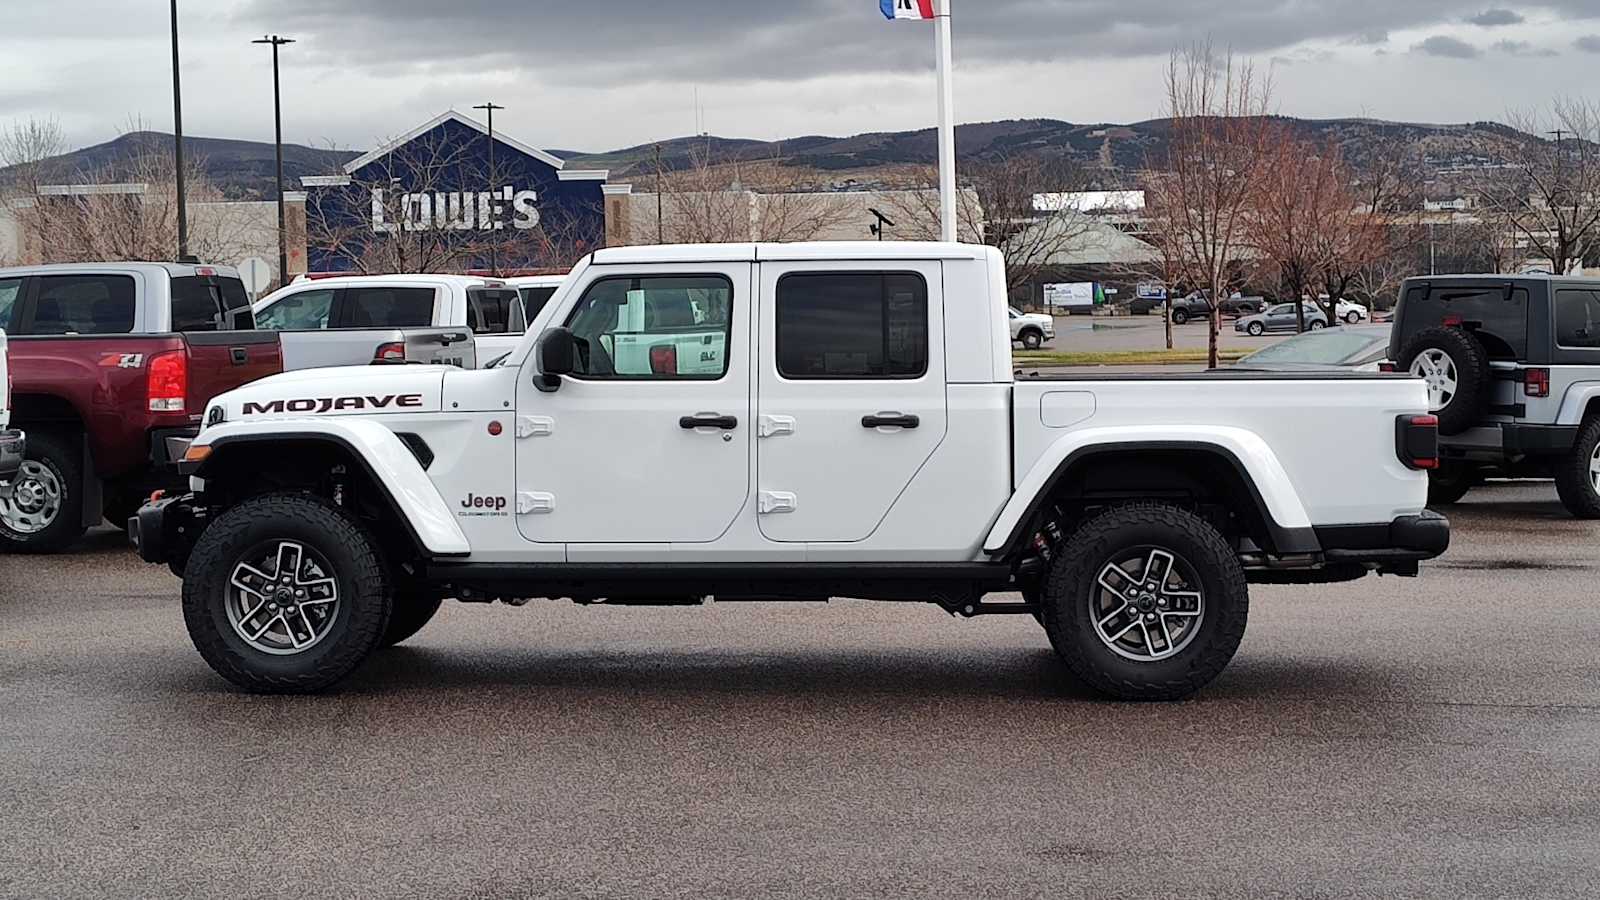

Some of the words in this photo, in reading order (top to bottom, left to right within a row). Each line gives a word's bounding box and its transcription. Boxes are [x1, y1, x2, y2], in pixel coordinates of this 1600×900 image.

[371, 185, 541, 232] LOWE'S
[242, 394, 423, 415] MOJAVE
[461, 492, 507, 511] Jeep
